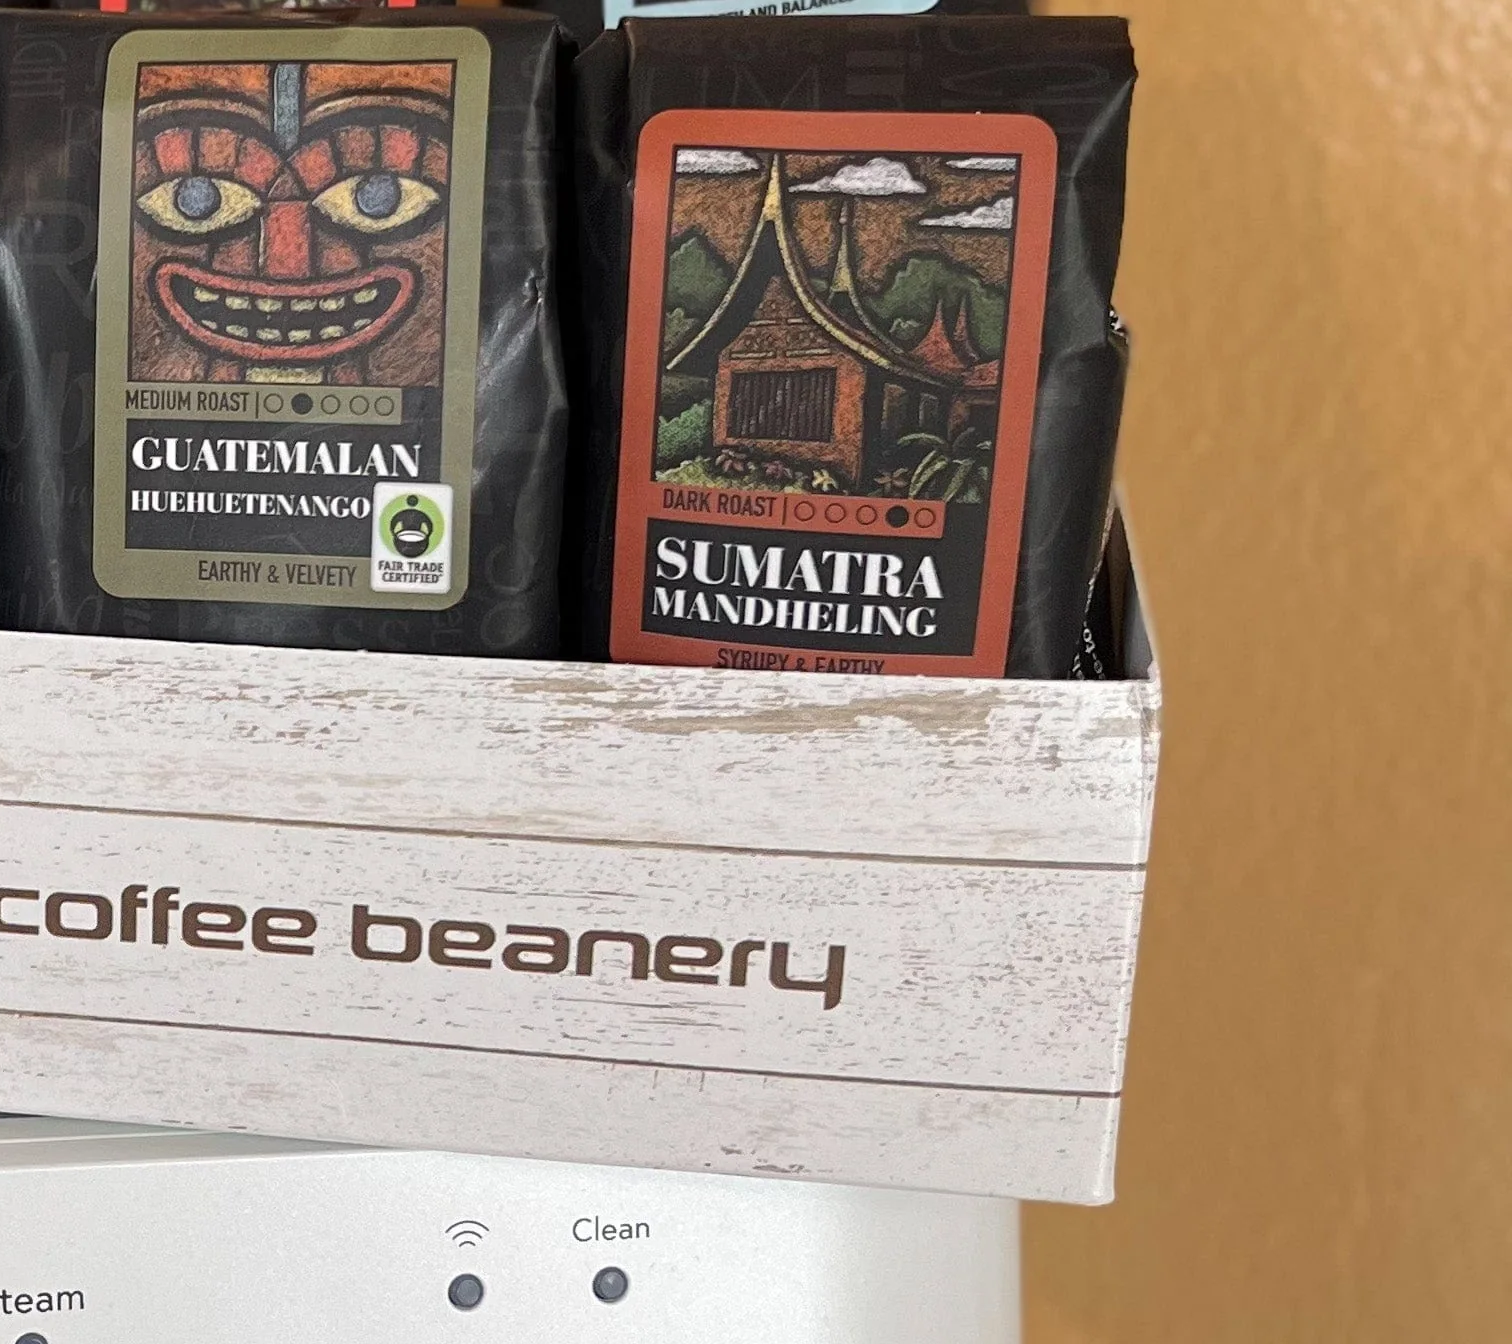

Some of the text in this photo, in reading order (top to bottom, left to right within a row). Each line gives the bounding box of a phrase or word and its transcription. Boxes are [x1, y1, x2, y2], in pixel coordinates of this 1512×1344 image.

[125, 390, 250, 413] MEDIUM ROAST
[131, 436, 421, 478] GUATEMALAN
[131, 490, 370, 519] HUEHUETENANGO
[663, 488, 777, 518] DARK ROAST
[198, 559, 357, 587] EARTHY & VELVETY
[378, 560, 444, 573] FAIR TRADE
[656, 536, 943, 599] SUMATRA
[652, 586, 938, 638] MANDHELING
[717, 648, 885, 674] SYRUPY & EARTHY
[351, 904, 847, 1010] beanery
[572, 1215, 650, 1242] Clean
